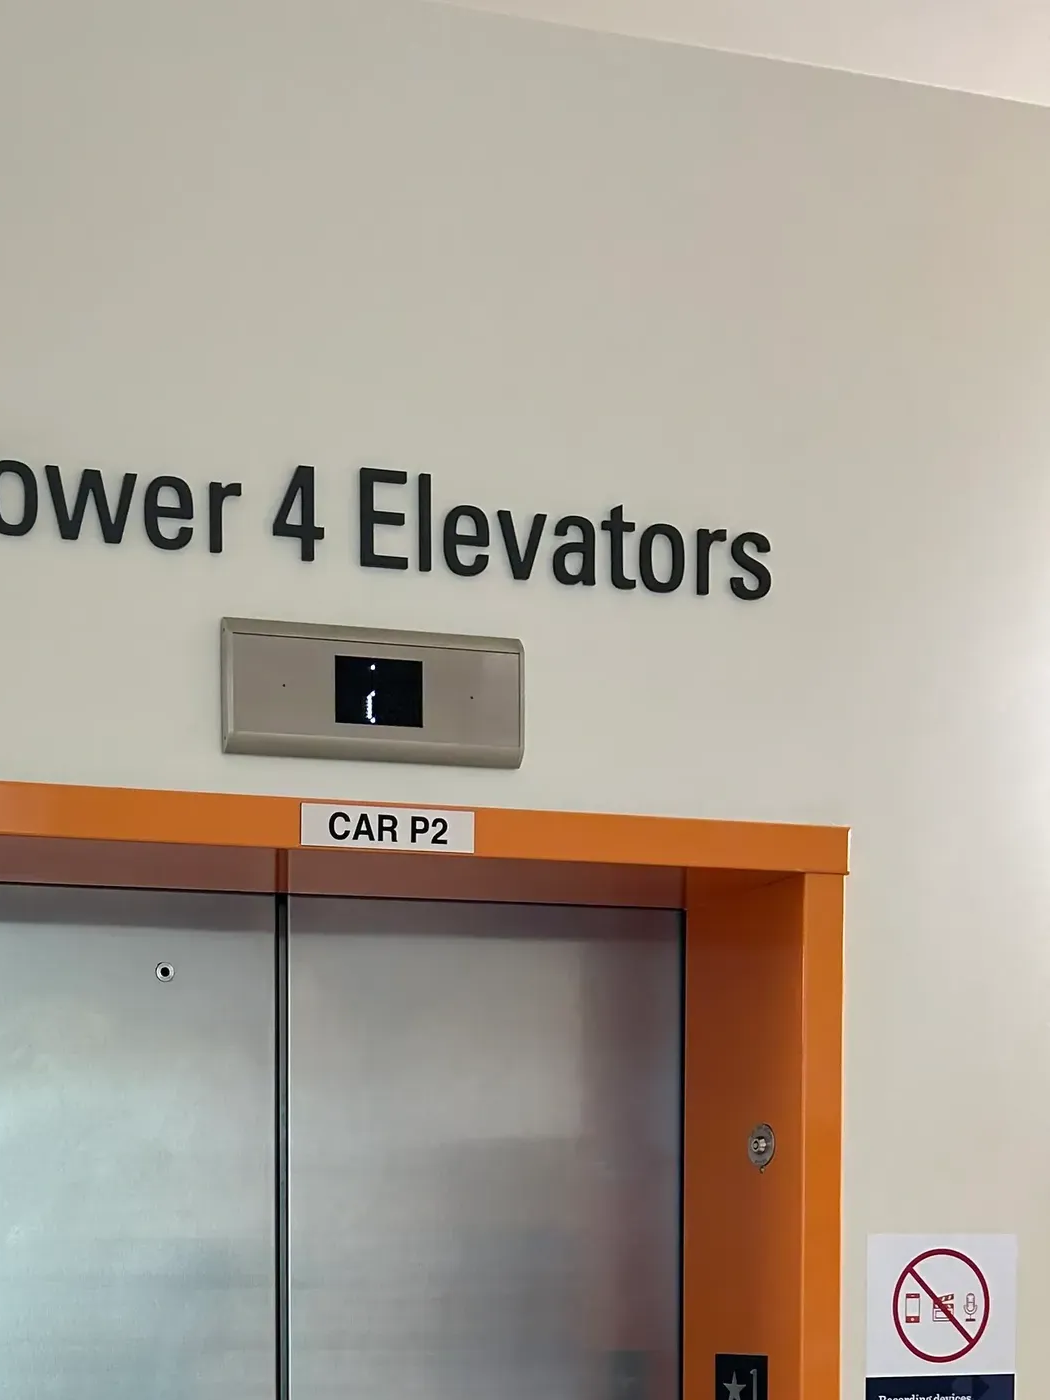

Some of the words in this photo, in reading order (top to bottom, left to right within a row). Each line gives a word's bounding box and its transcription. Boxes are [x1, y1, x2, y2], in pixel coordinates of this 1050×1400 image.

[272, 464, 325, 562] 4
[359, 466, 773, 601] Elevators
[328, 811, 398, 843] CAR
[410, 815, 448, 845] P2
